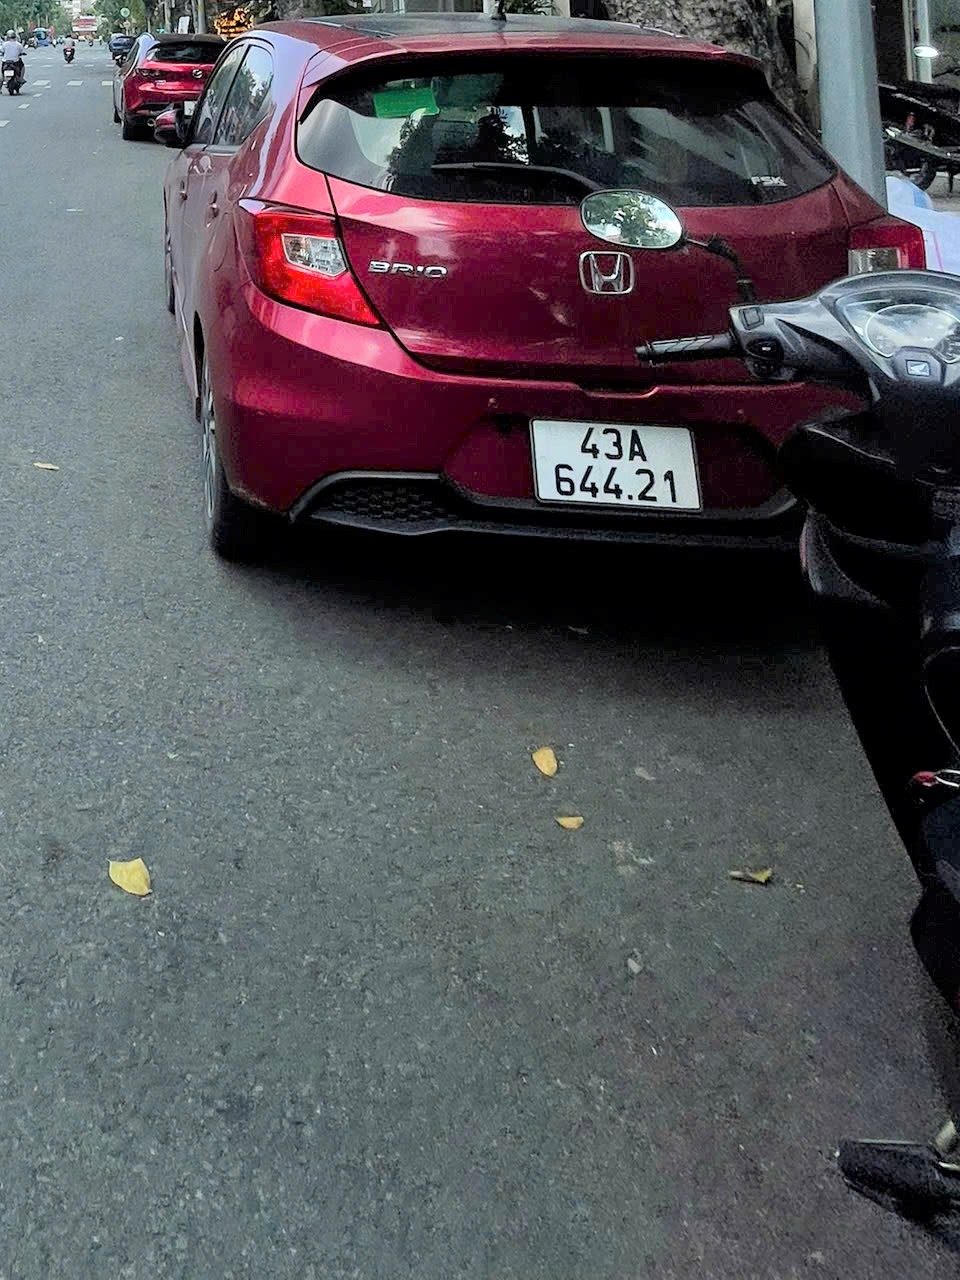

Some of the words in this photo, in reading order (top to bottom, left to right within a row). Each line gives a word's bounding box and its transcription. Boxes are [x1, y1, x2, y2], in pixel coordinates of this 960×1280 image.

[367, 260, 448, 278] BRIO
[581, 426, 647, 462] 43A
[554, 463, 677, 503] 644.21
